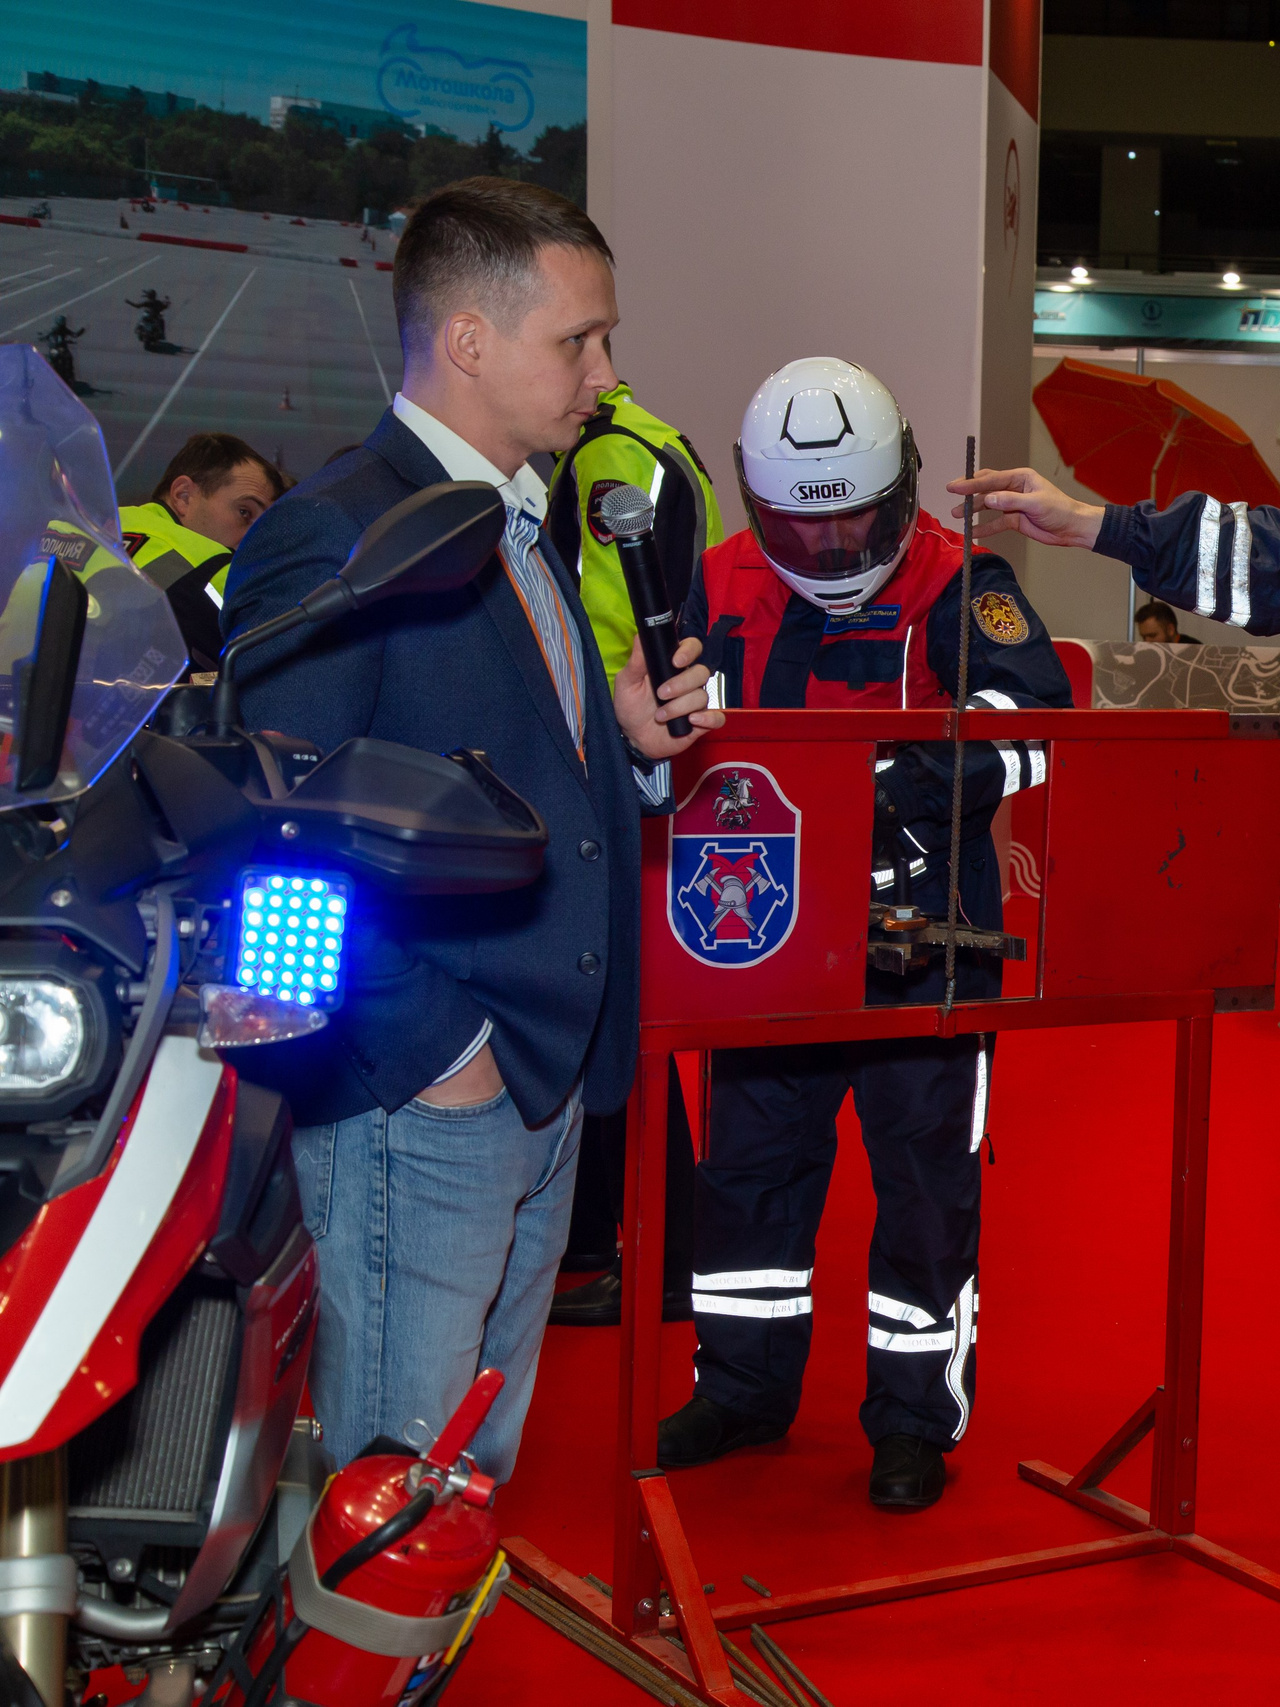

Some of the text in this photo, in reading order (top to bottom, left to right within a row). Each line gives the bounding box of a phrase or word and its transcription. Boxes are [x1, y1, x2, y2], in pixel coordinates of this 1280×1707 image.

[394, 67, 516, 104] Мотошкола
[798, 482, 847, 500] SHOEI
[41, 537, 86, 560] ОЛИЦИЯ
